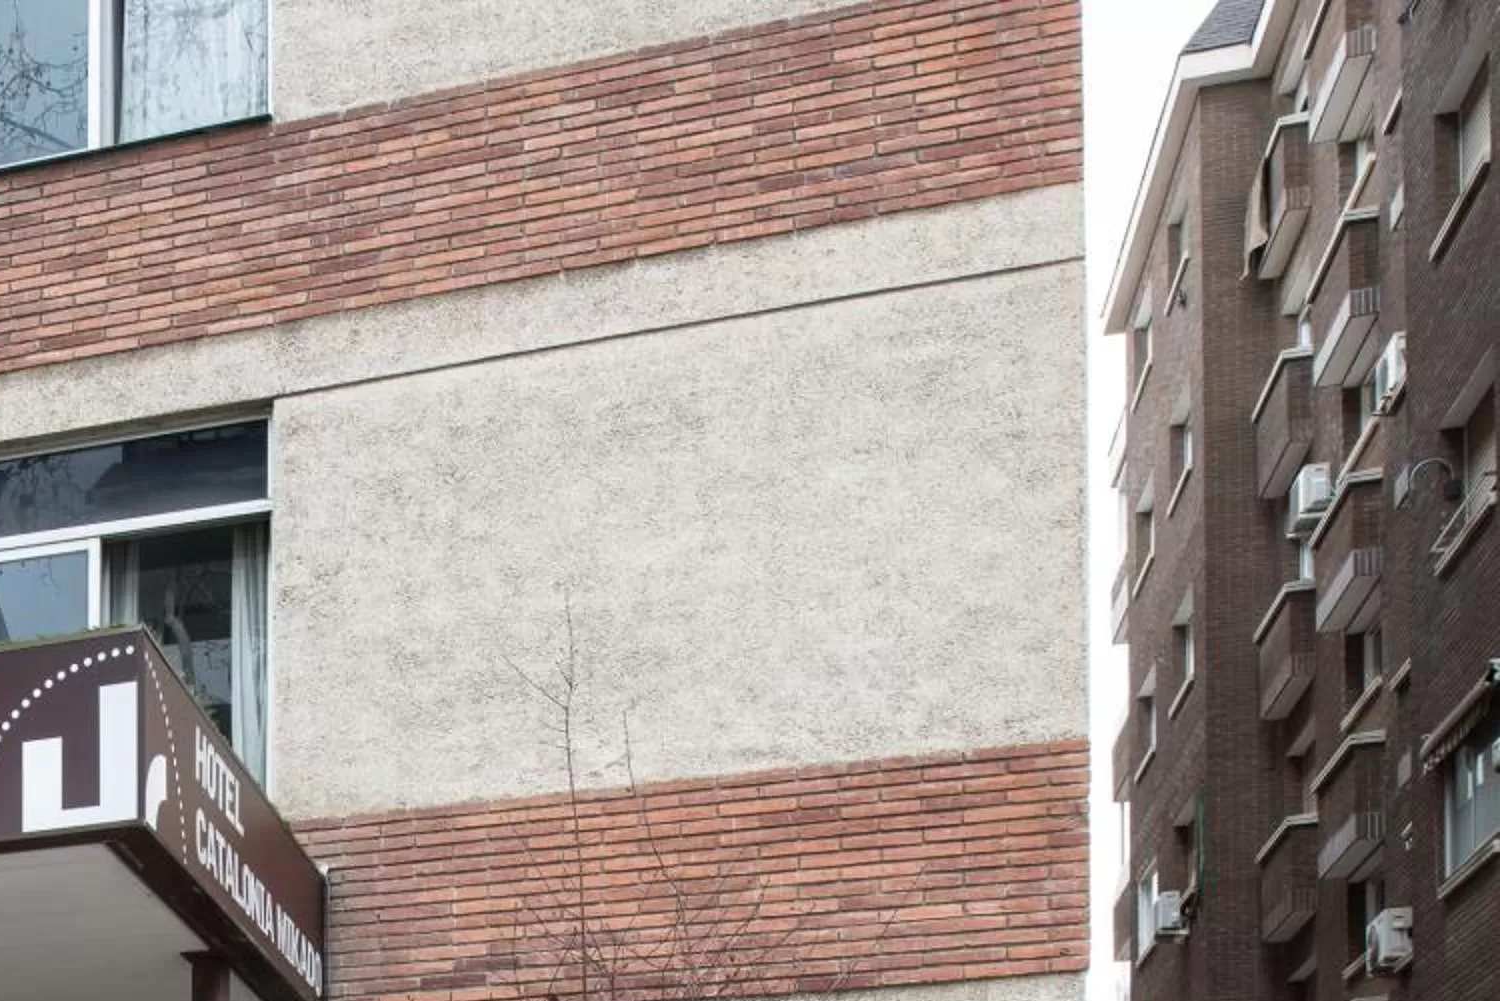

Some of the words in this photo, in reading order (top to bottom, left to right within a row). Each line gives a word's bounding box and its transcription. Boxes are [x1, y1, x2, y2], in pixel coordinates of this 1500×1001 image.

[194, 726, 244, 837] HOTEL
[195, 807, 275, 943] CATALONIA
[276, 903, 323, 997] MIKADO
